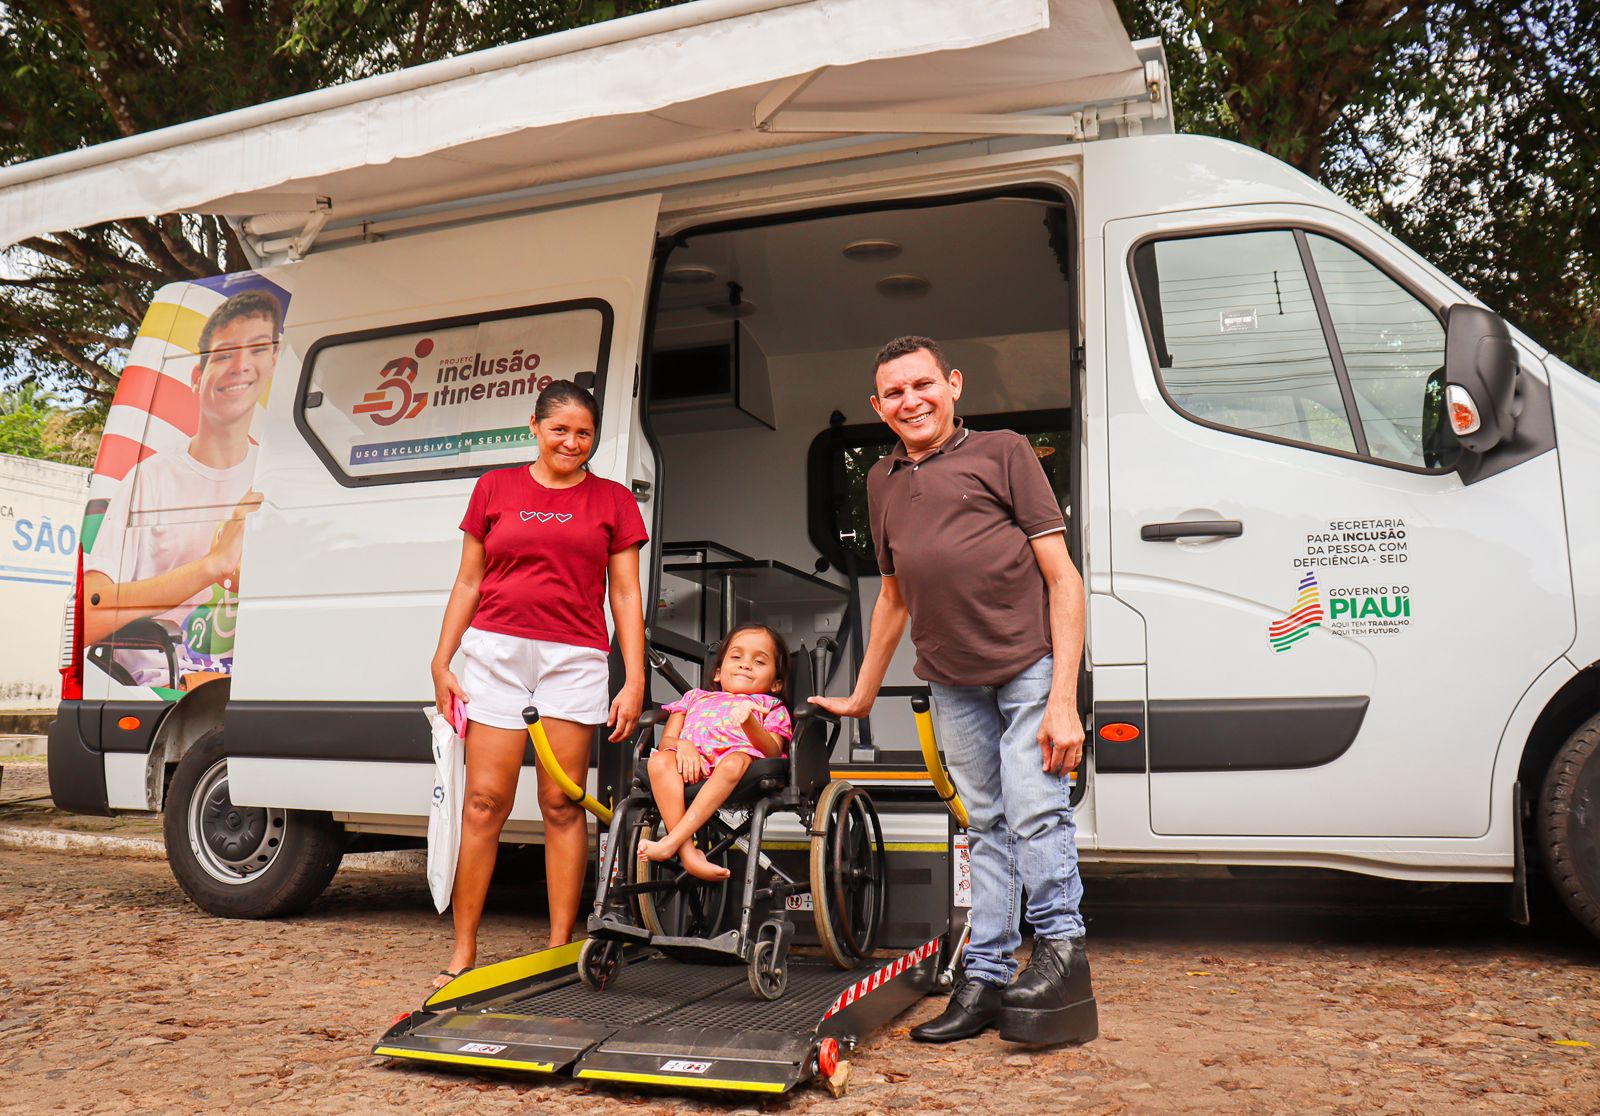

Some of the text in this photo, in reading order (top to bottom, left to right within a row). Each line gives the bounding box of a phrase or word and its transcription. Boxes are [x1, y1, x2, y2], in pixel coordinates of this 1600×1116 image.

[437, 349, 540, 384] inclusão
[433, 372, 553, 407] itinerante
[356, 450, 378, 458] USO
[383, 442, 452, 456] EXCLUSIVO
[478, 433, 535, 445] SERVIÇO
[1329, 518, 1405, 531] SECRETARIA
[12, 515, 76, 556] SÃO
[1307, 529, 1406, 543] PARA INCLUSÃO
[1307, 542, 1408, 555] DA PESSOA COM
[1293, 555, 1370, 567] DEFICIÊNCIA
[1379, 554, 1408, 564] SEID
[1329, 585, 1410, 597] GOVERNO DO
